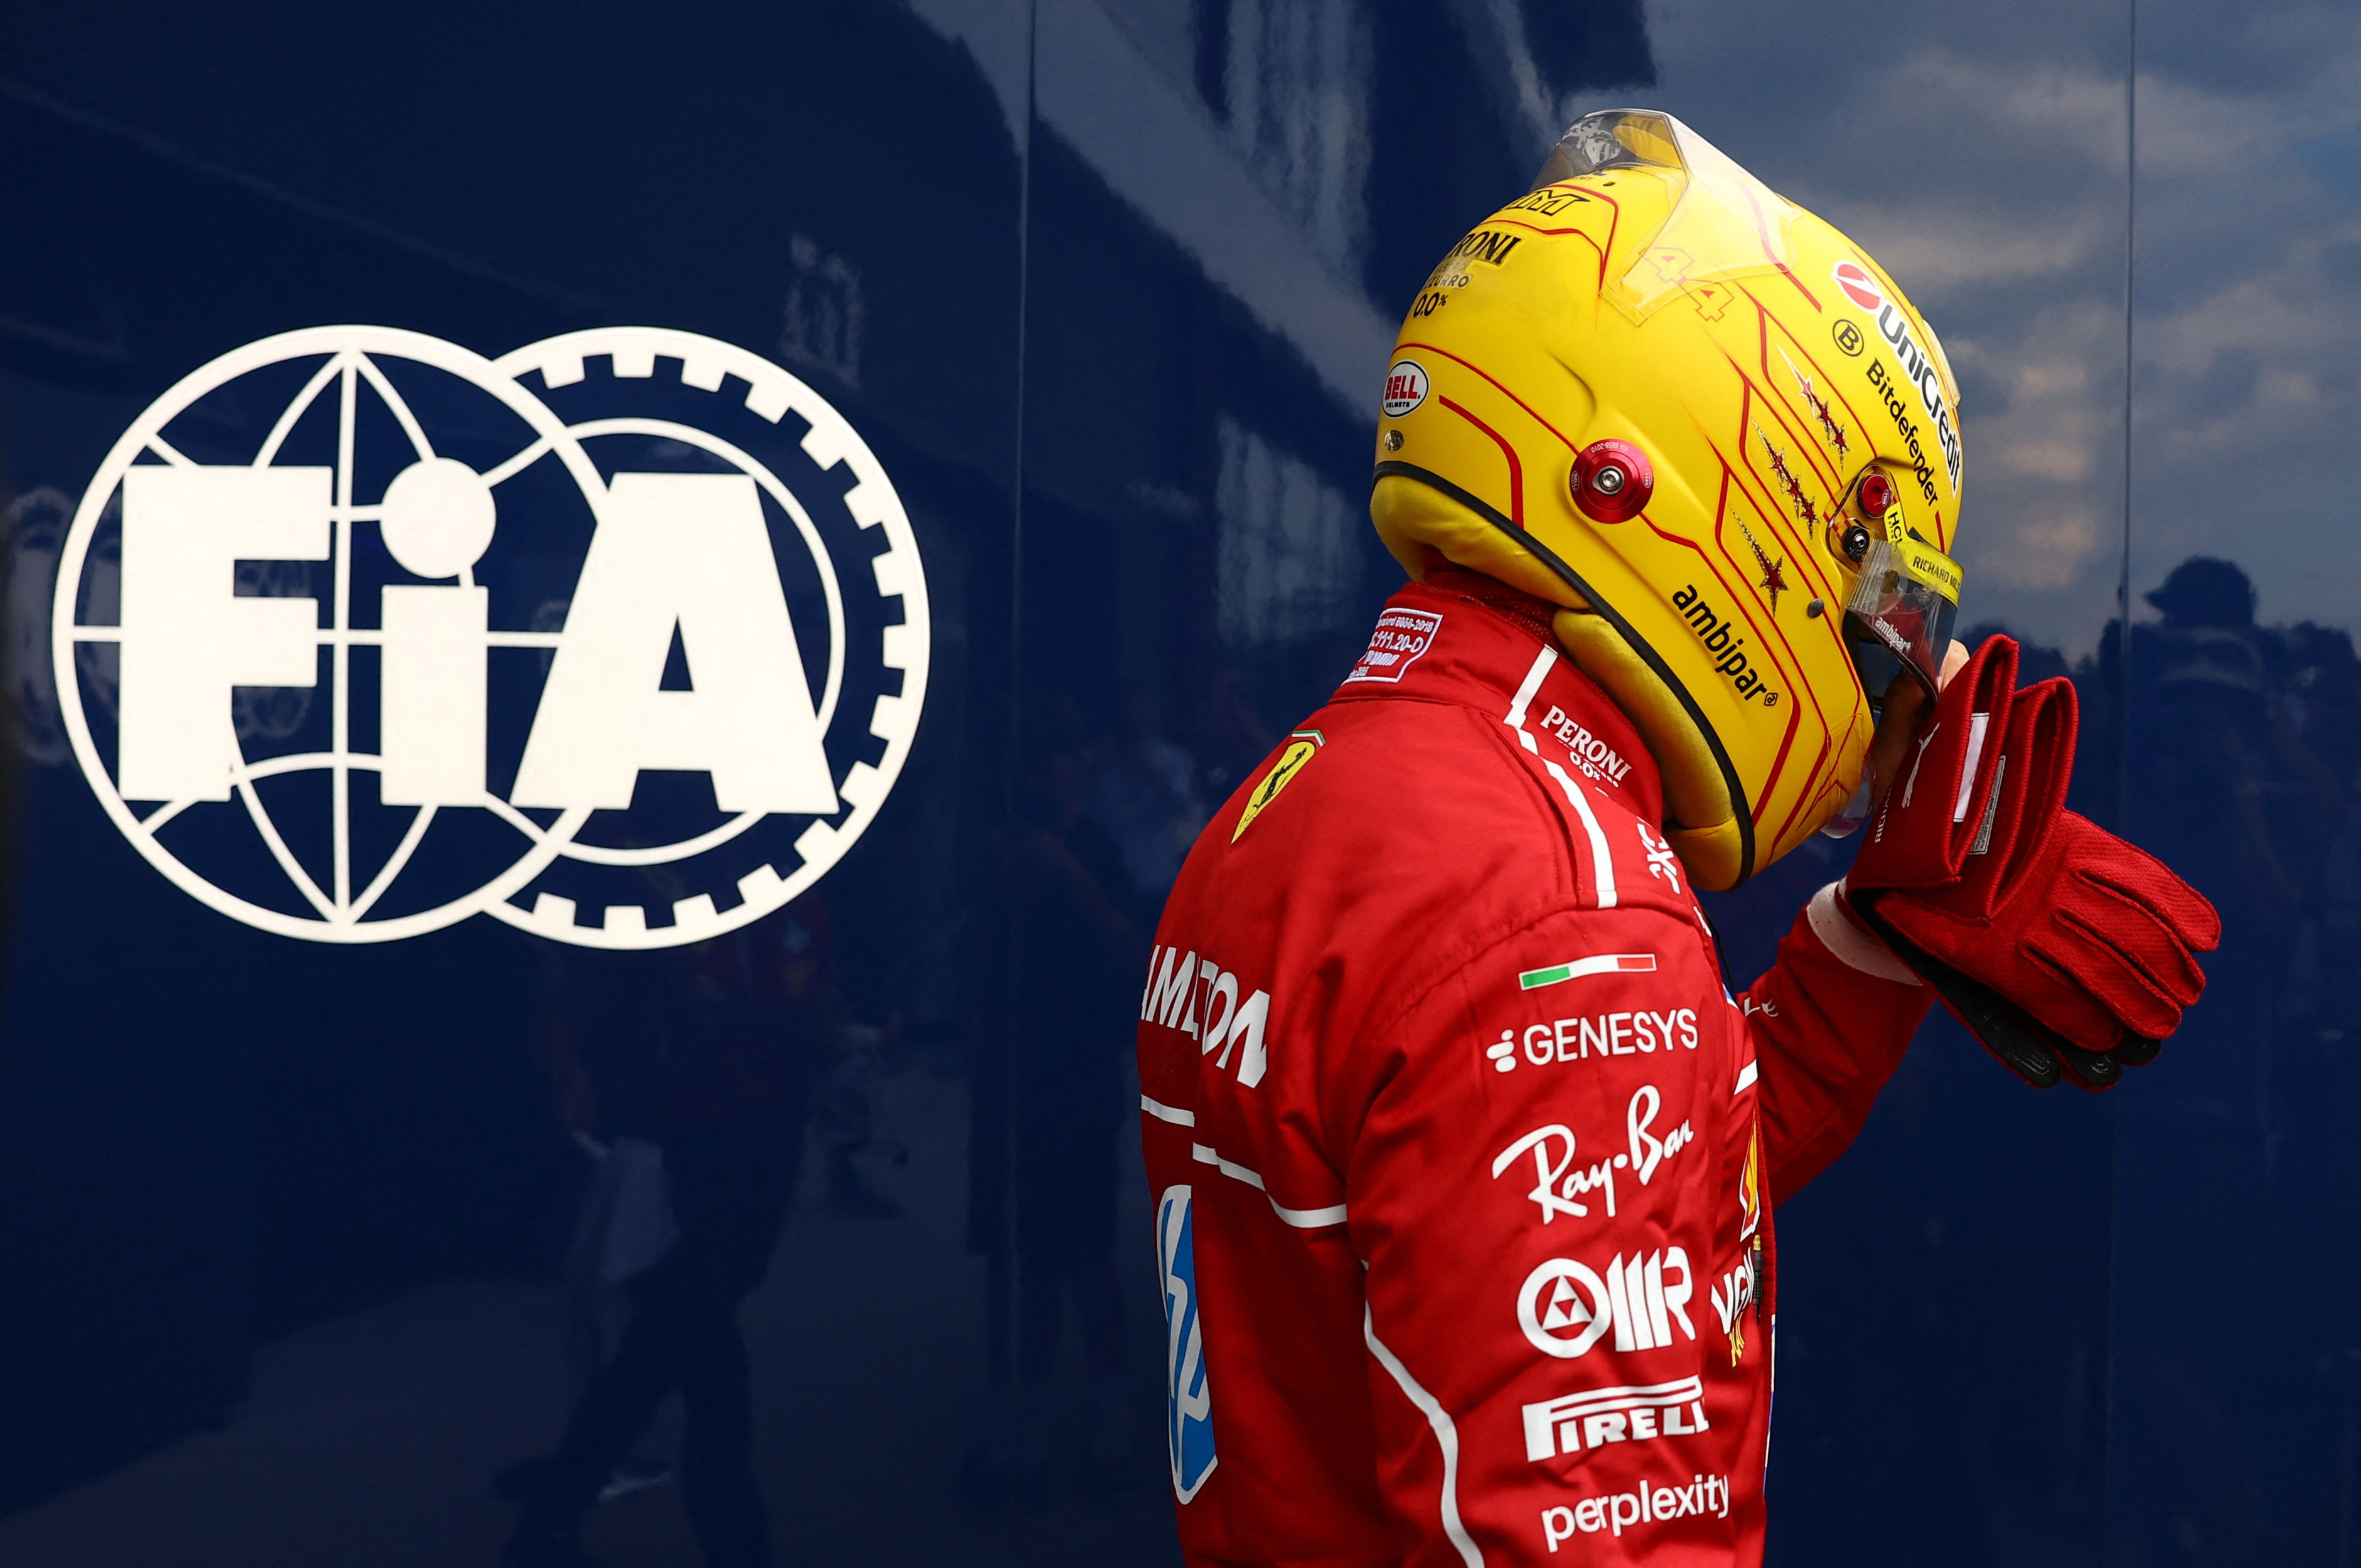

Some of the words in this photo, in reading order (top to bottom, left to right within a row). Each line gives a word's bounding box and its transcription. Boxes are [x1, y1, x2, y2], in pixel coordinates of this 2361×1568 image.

[1448, 231, 1522, 266] RONI
[1385, 375, 1418, 400] BELL
[1879, 305, 1961, 491] UniCredit
[1866, 358, 1938, 508] Bitdefender
[1913, 555, 1949, 583] RICHARD
[1672, 584, 1768, 702] ambipar
[1875, 616, 1907, 651] ambipar
[1540, 705, 1632, 781] PERONI
[1523, 1008, 1698, 1065] GENESYS
[1521, 1375, 1710, 1463] PIRELL
[1541, 1474, 1730, 1552] perplexity
